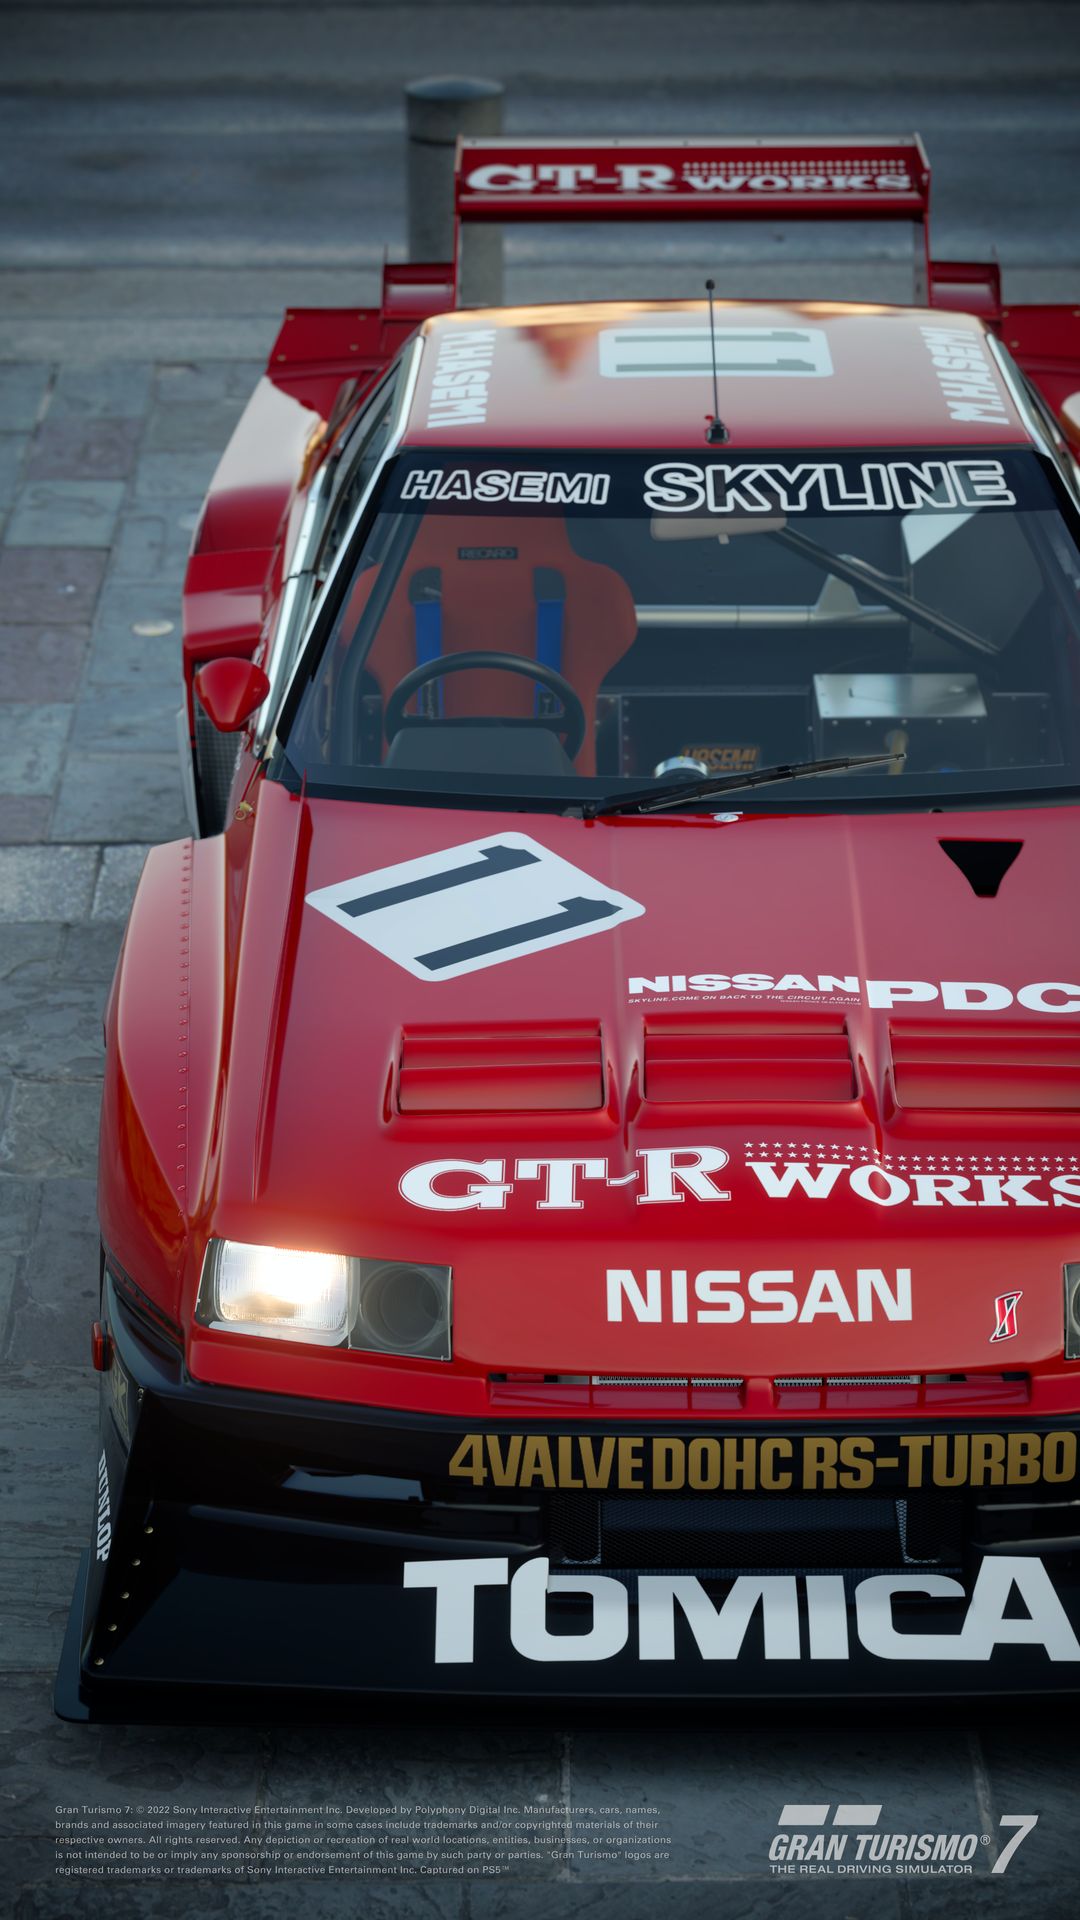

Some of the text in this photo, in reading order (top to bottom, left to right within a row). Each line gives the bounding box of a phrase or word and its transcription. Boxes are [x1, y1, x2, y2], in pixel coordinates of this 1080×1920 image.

[466, 163, 912, 193] GT-R WORKS
[401, 460, 1016, 513] HASEMI SKYLINE
[336, 844, 623, 971] 11
[628, 973, 860, 994] NISSAN
[399, 1145, 731, 1211] GT-R
[606, 1268, 913, 1323] NISSAN
[652, 1437, 793, 1490] DOHC
[803, 1431, 1077, 1490] RS-TURBO
[96, 1449, 112, 1562] DUNLOP
[403, 1555, 1080, 1664] TOMICA
